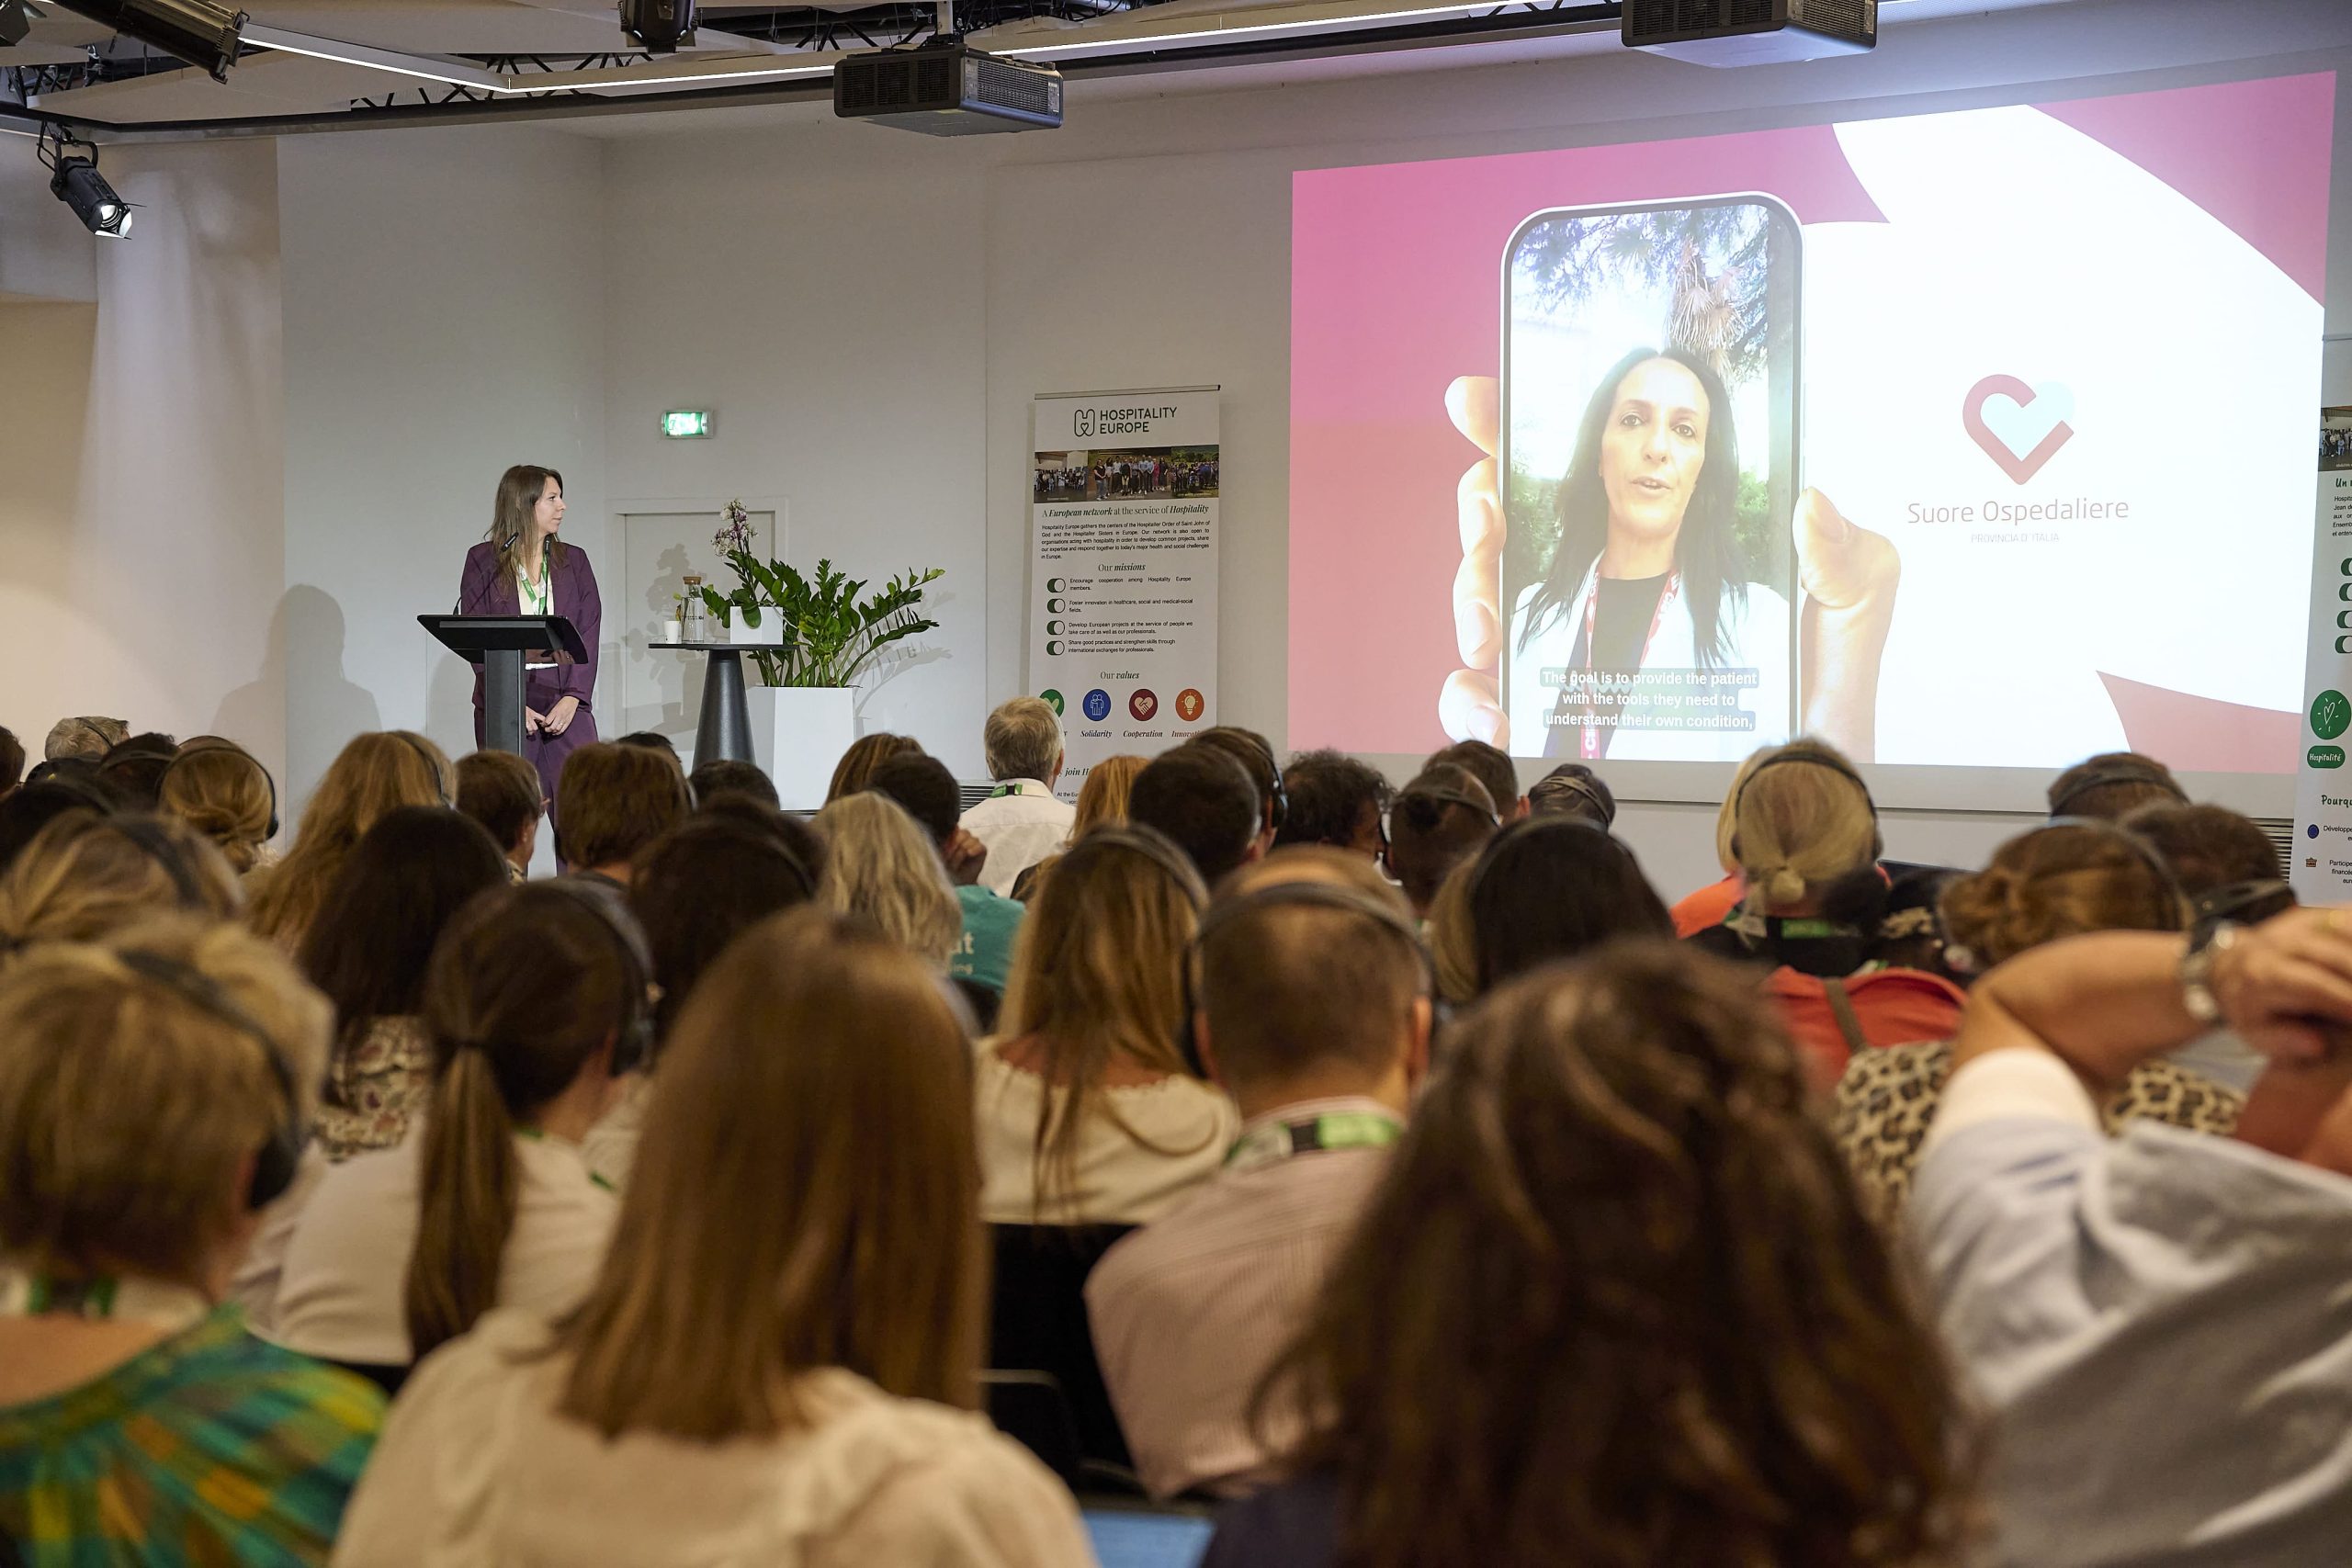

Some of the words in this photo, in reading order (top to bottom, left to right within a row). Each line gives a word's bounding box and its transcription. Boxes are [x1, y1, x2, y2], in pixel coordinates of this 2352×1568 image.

[1100, 407, 1177, 420] HOSPITALITY
[1100, 422, 1149, 434] EUROPE
[1049, 510, 1081, 518] European
[1083, 507, 1113, 515] network
[1135, 506, 1159, 514] service
[1161, 505, 1169, 513] of
[1170, 504, 1209, 514] Hospitality
[1907, 503, 1973, 524] Suore
[1983, 498, 2129, 525] Ospedaliere
[1971, 533, 2018, 543] PROVINCIA
[1099, 564, 1113, 572] Our
[1114, 563, 1146, 571] missions
[1101, 671, 1114, 680] Our
[1116, 671, 1139, 680] values
[1543, 671, 1566, 683] The
[1570, 671, 1597, 686] goal
[1601, 671, 1612, 684] is
[1616, 672, 1629, 684] to
[1633, 671, 1682, 686] provide
[1687, 671, 1708, 684] the
[1711, 672, 1758, 686] patient
[1563, 693, 1589, 705] with
[1593, 693, 1613, 705] the
[1617, 693, 1649, 705] tools
[1653, 693, 1681, 708] they
[1685, 694, 1718, 705] need
[1722, 694, 1735, 705] to
[1546, 714, 1618, 726] understand
[1622, 714, 1652, 727] their
[1656, 716, 1683, 727] own
[1080, 730, 1112, 739] Solidarity
[1123, 730, 1163, 739] Cooperation
[2310, 753, 2341, 762] Hospitalité
[1065, 768, 1080, 776] join
